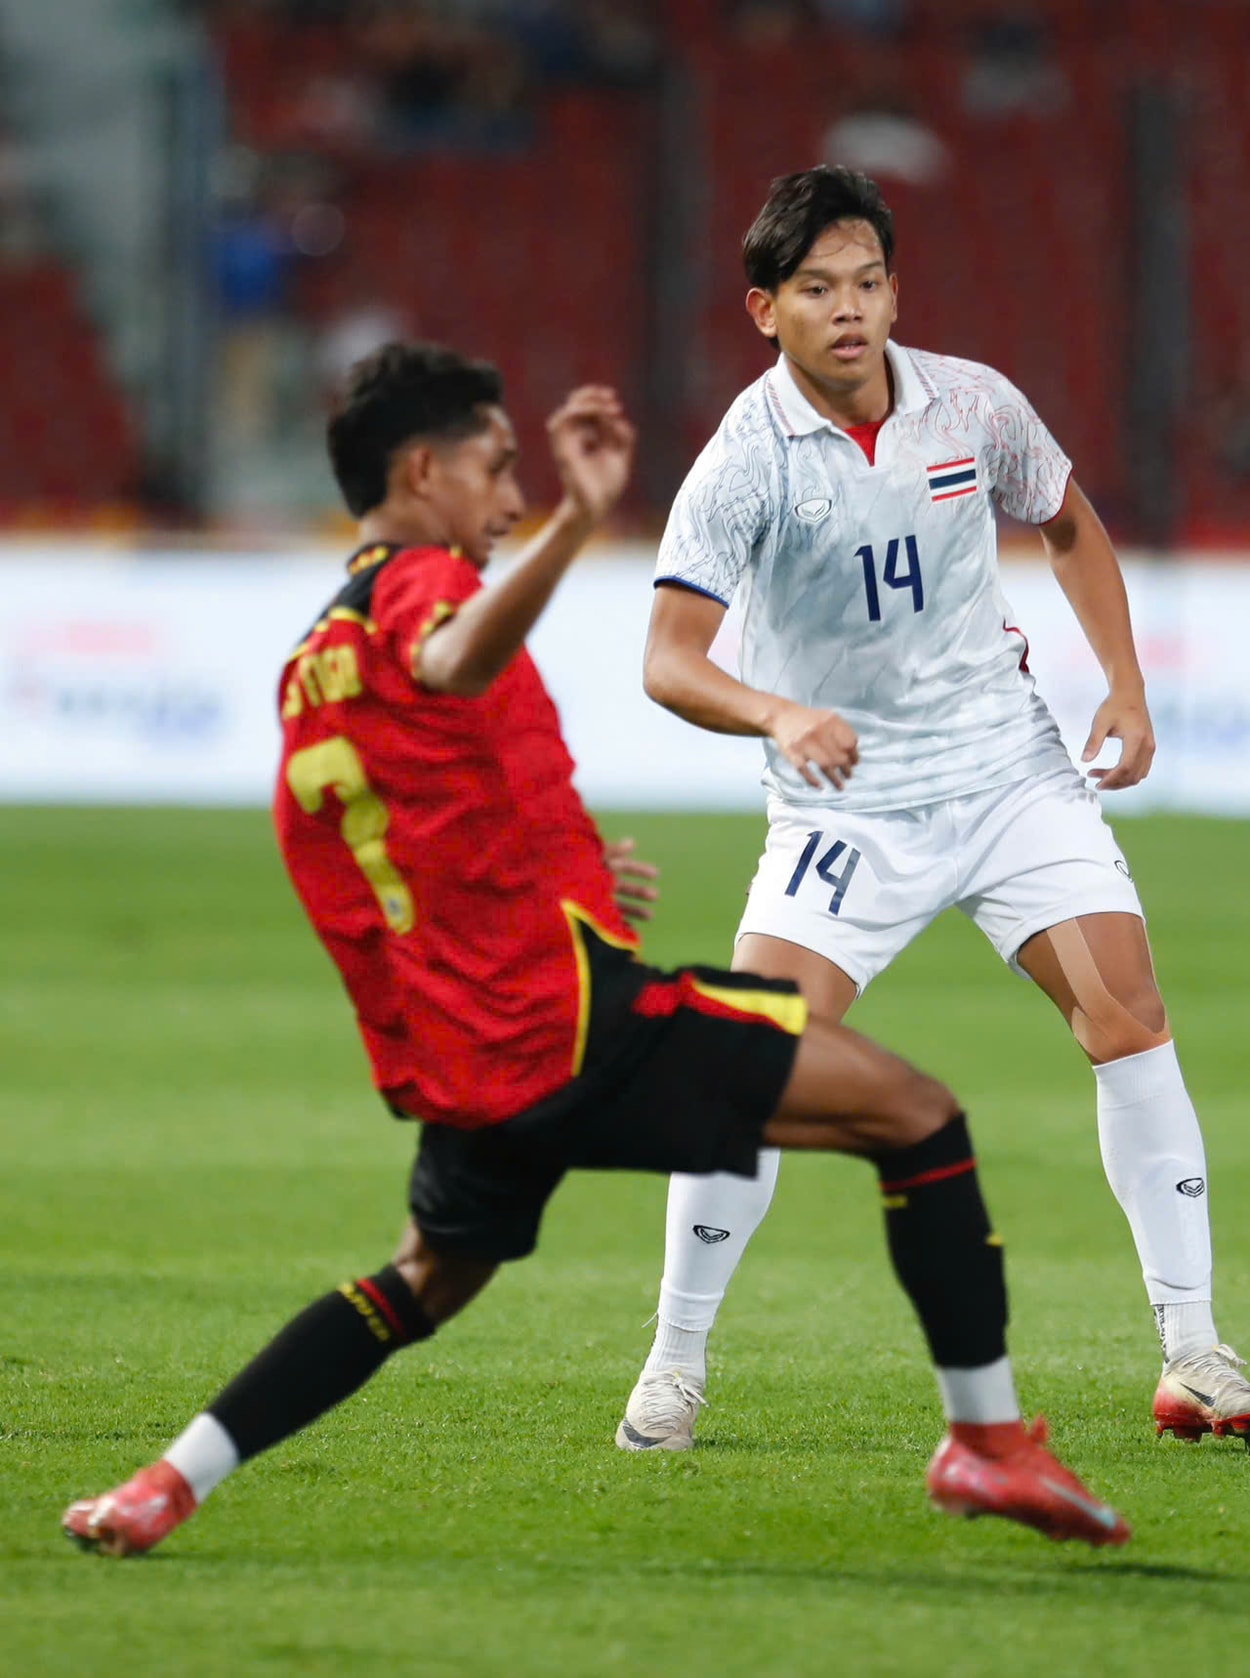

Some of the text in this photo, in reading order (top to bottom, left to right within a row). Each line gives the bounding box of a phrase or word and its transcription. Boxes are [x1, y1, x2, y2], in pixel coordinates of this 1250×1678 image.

[854, 535, 924, 622] 14
[287, 736, 414, 935] 7
[785, 830, 861, 916] 14
